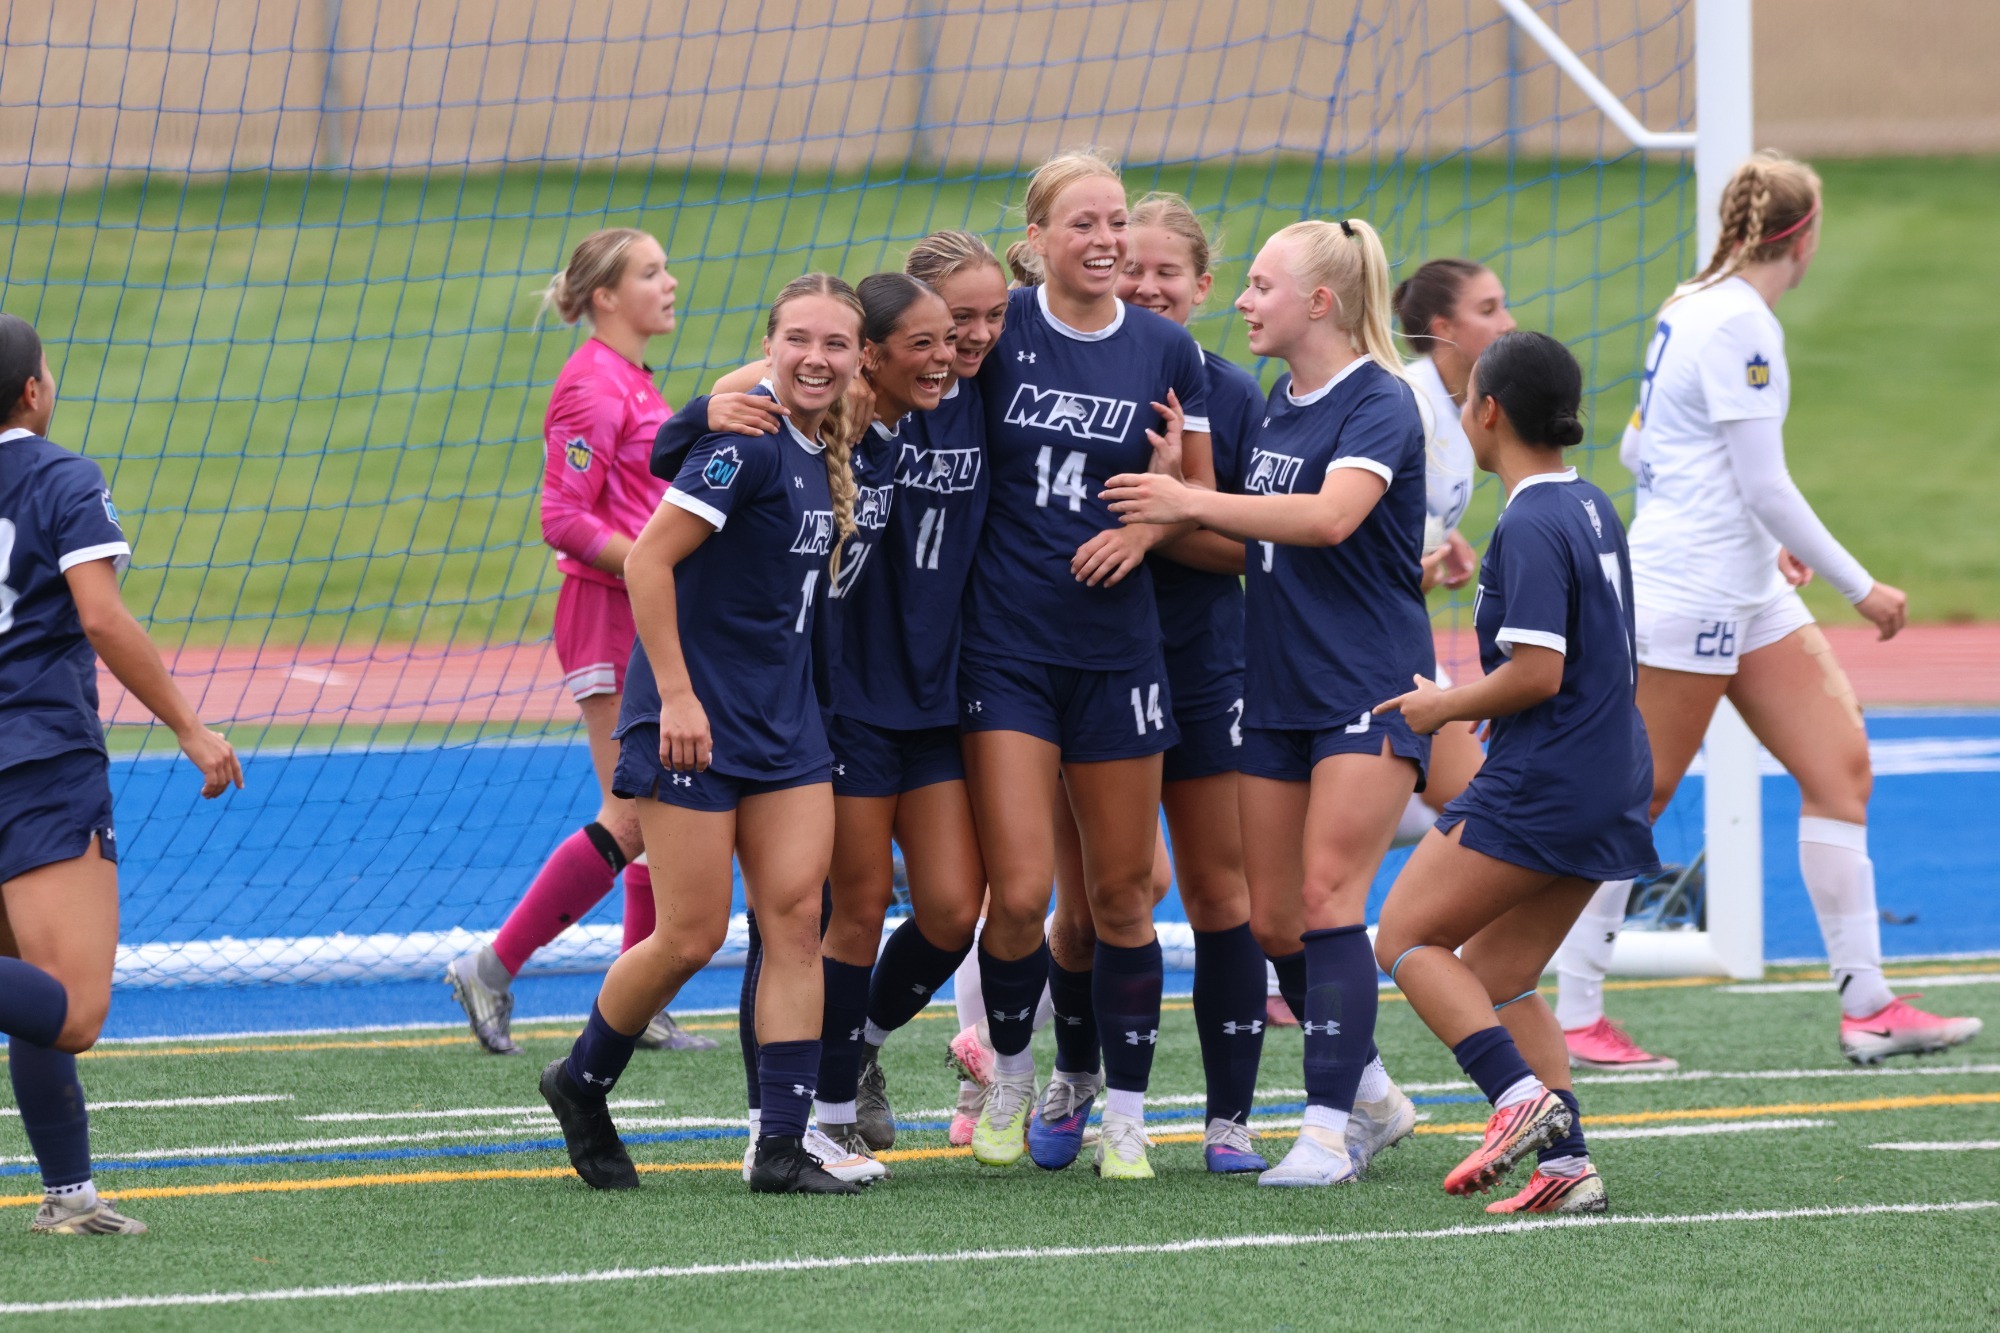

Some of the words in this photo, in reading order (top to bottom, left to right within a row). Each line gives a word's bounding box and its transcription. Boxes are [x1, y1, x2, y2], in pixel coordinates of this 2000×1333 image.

[1004, 383, 1137, 443] MRU
[707, 459, 736, 484] CW
[894, 443, 981, 494] MRU
[1035, 445, 1087, 512] 14
[915, 507, 946, 570] 11
[828, 542, 872, 599] 21
[1131, 683, 1164, 736] 14
